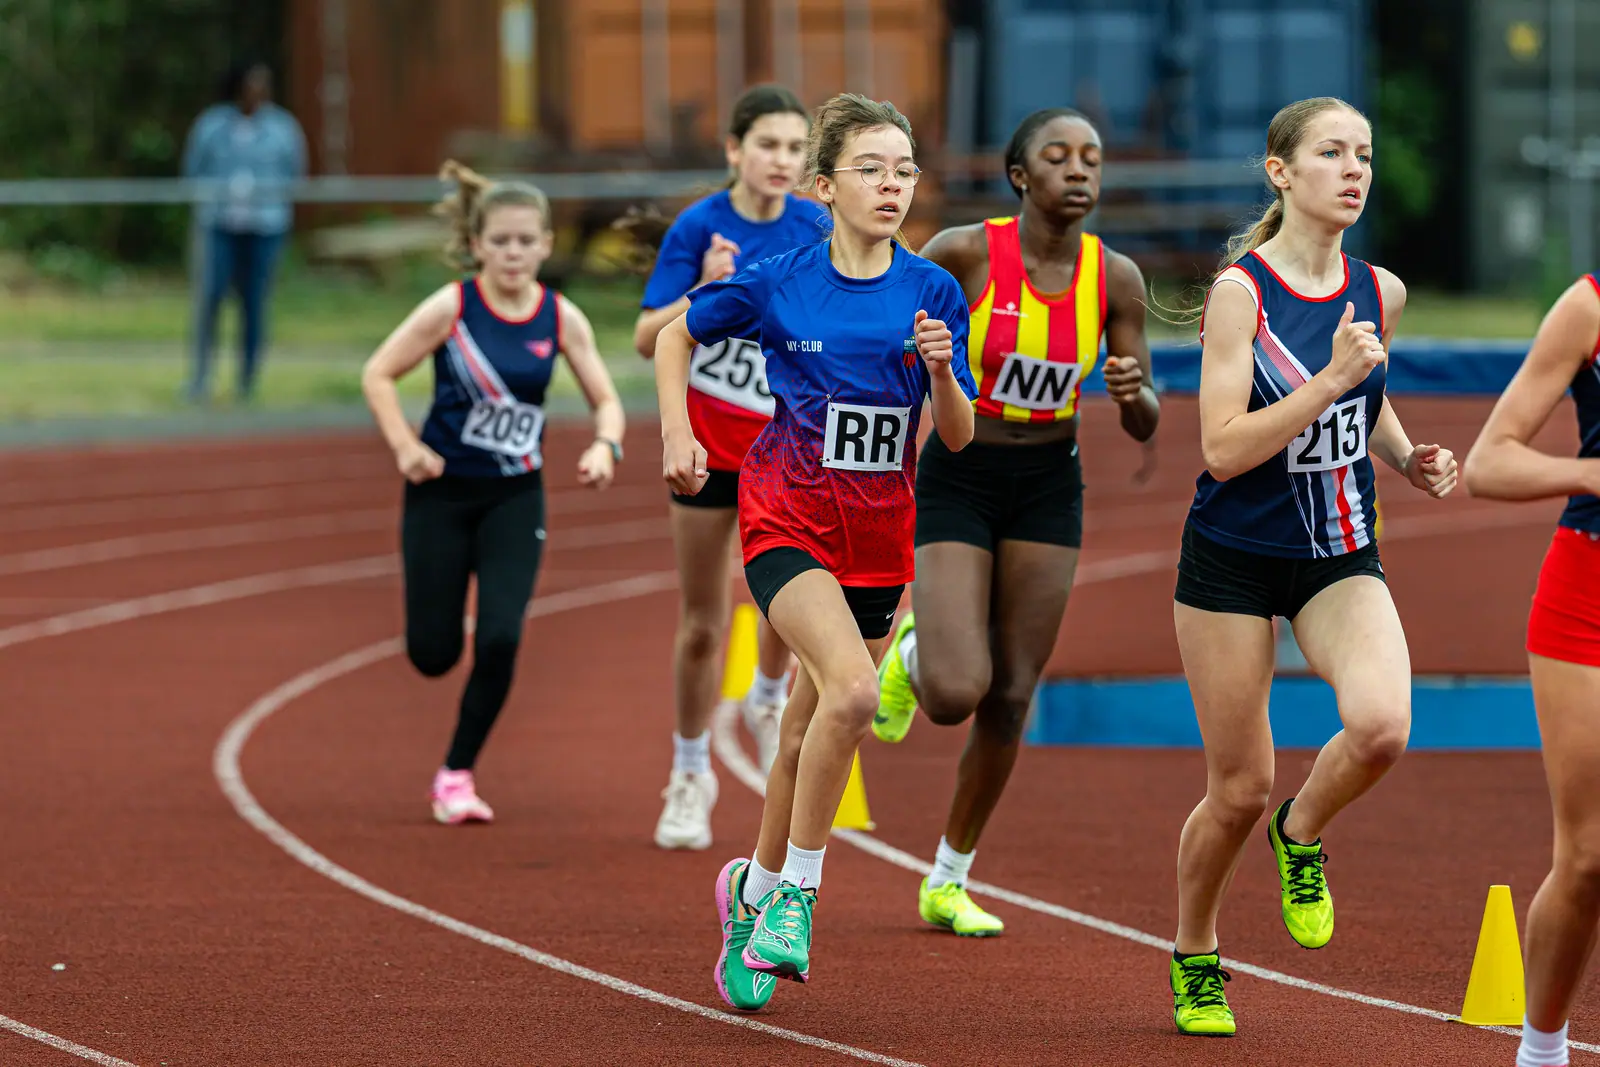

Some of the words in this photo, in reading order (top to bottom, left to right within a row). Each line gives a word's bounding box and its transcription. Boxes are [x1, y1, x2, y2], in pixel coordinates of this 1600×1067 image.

[1001, 359, 1073, 402] NN
[471, 404, 535, 446] 209
[834, 410, 901, 464] RR
[1296, 404, 1361, 465] 213
